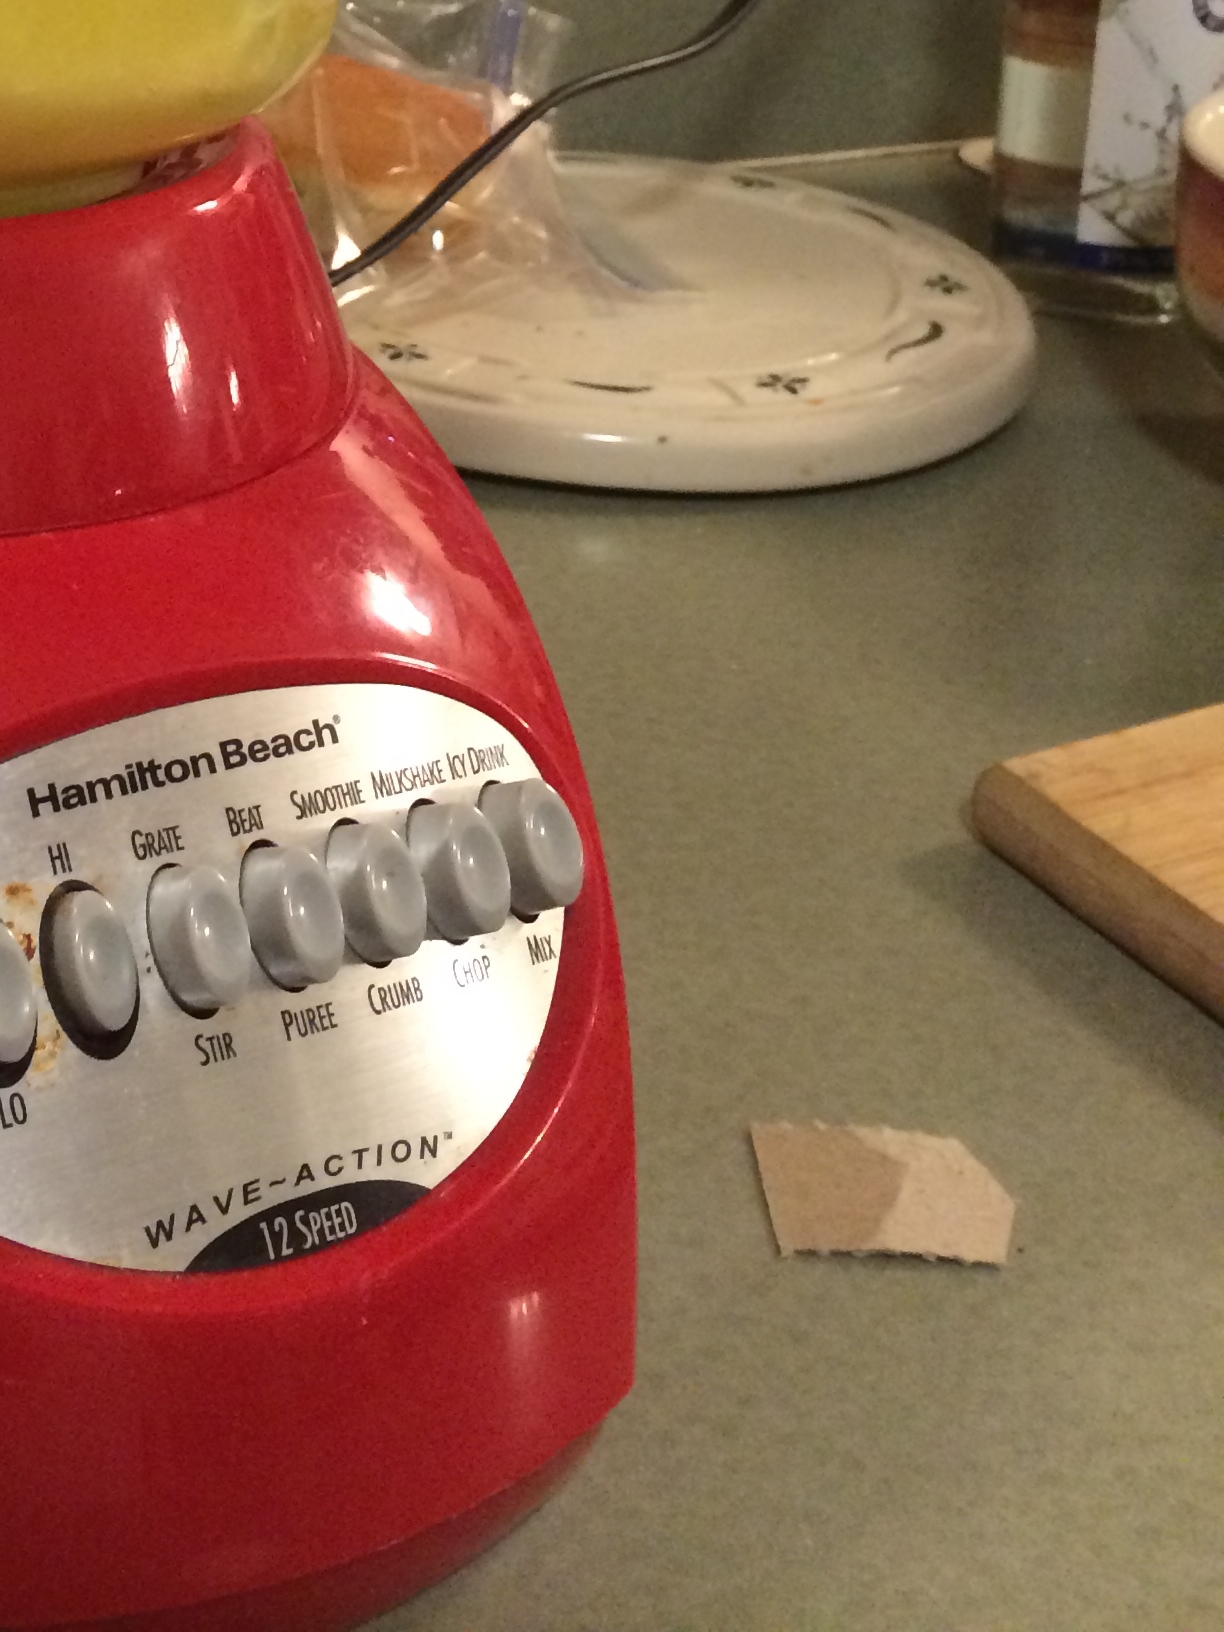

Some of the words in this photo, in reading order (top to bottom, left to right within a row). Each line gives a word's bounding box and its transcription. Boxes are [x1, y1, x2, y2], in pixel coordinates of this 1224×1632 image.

[27, 751, 218, 818] Hamilton
[219, 718, 340, 770] Beach
[370, 759, 447, 799] MILKSHAKE
[446, 752, 469, 781] ICY
[468, 743, 510, 776] DRINK
[289, 779, 366, 820] SMOOTHIE
[225, 805, 265, 837] BEAT
[47, 842, 73, 875] HI
[131, 825, 185, 860] GRATE
[526, 934, 557, 965] MIX
[452, 955, 492, 988] CHOP
[367, 976, 424, 1015] CRUMB
[280, 1001, 339, 1041] PUREE
[194, 1032, 237, 1066] STIR
[259, 1216, 294, 1261] 12
[294, 1201, 358, 1251] SPEED
